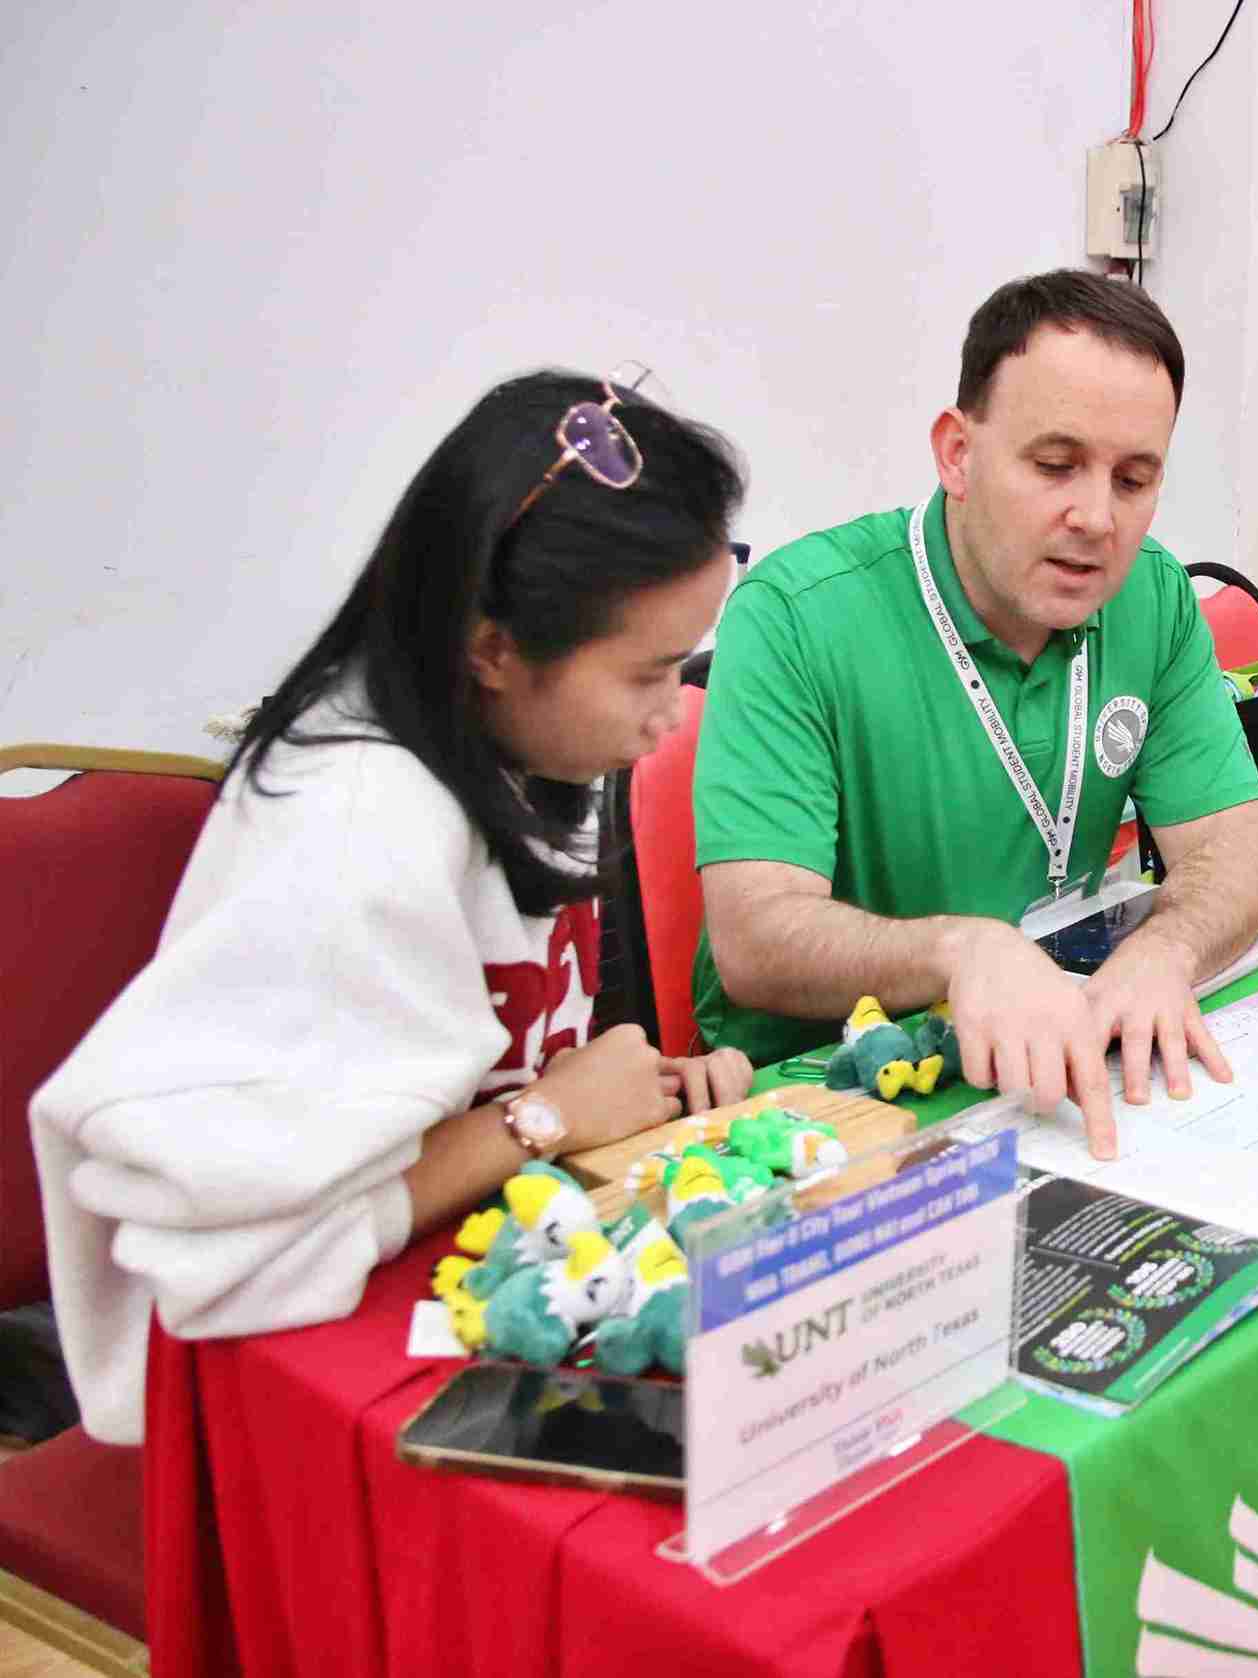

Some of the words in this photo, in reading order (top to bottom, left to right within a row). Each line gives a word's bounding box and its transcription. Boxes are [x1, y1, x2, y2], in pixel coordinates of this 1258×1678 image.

[932, 602, 959, 647] GLOBAL
[977, 694, 1008, 745] MOBILITY
[1001, 744, 1032, 793] STUDENT
[1025, 791, 1052, 828] GLOBAL
[775, 1296, 853, 1364] UNT
[739, 1378, 842, 1447] University
[849, 1359, 868, 1389] of
[874, 1329, 927, 1375] North
[932, 1302, 978, 1343] Texas
